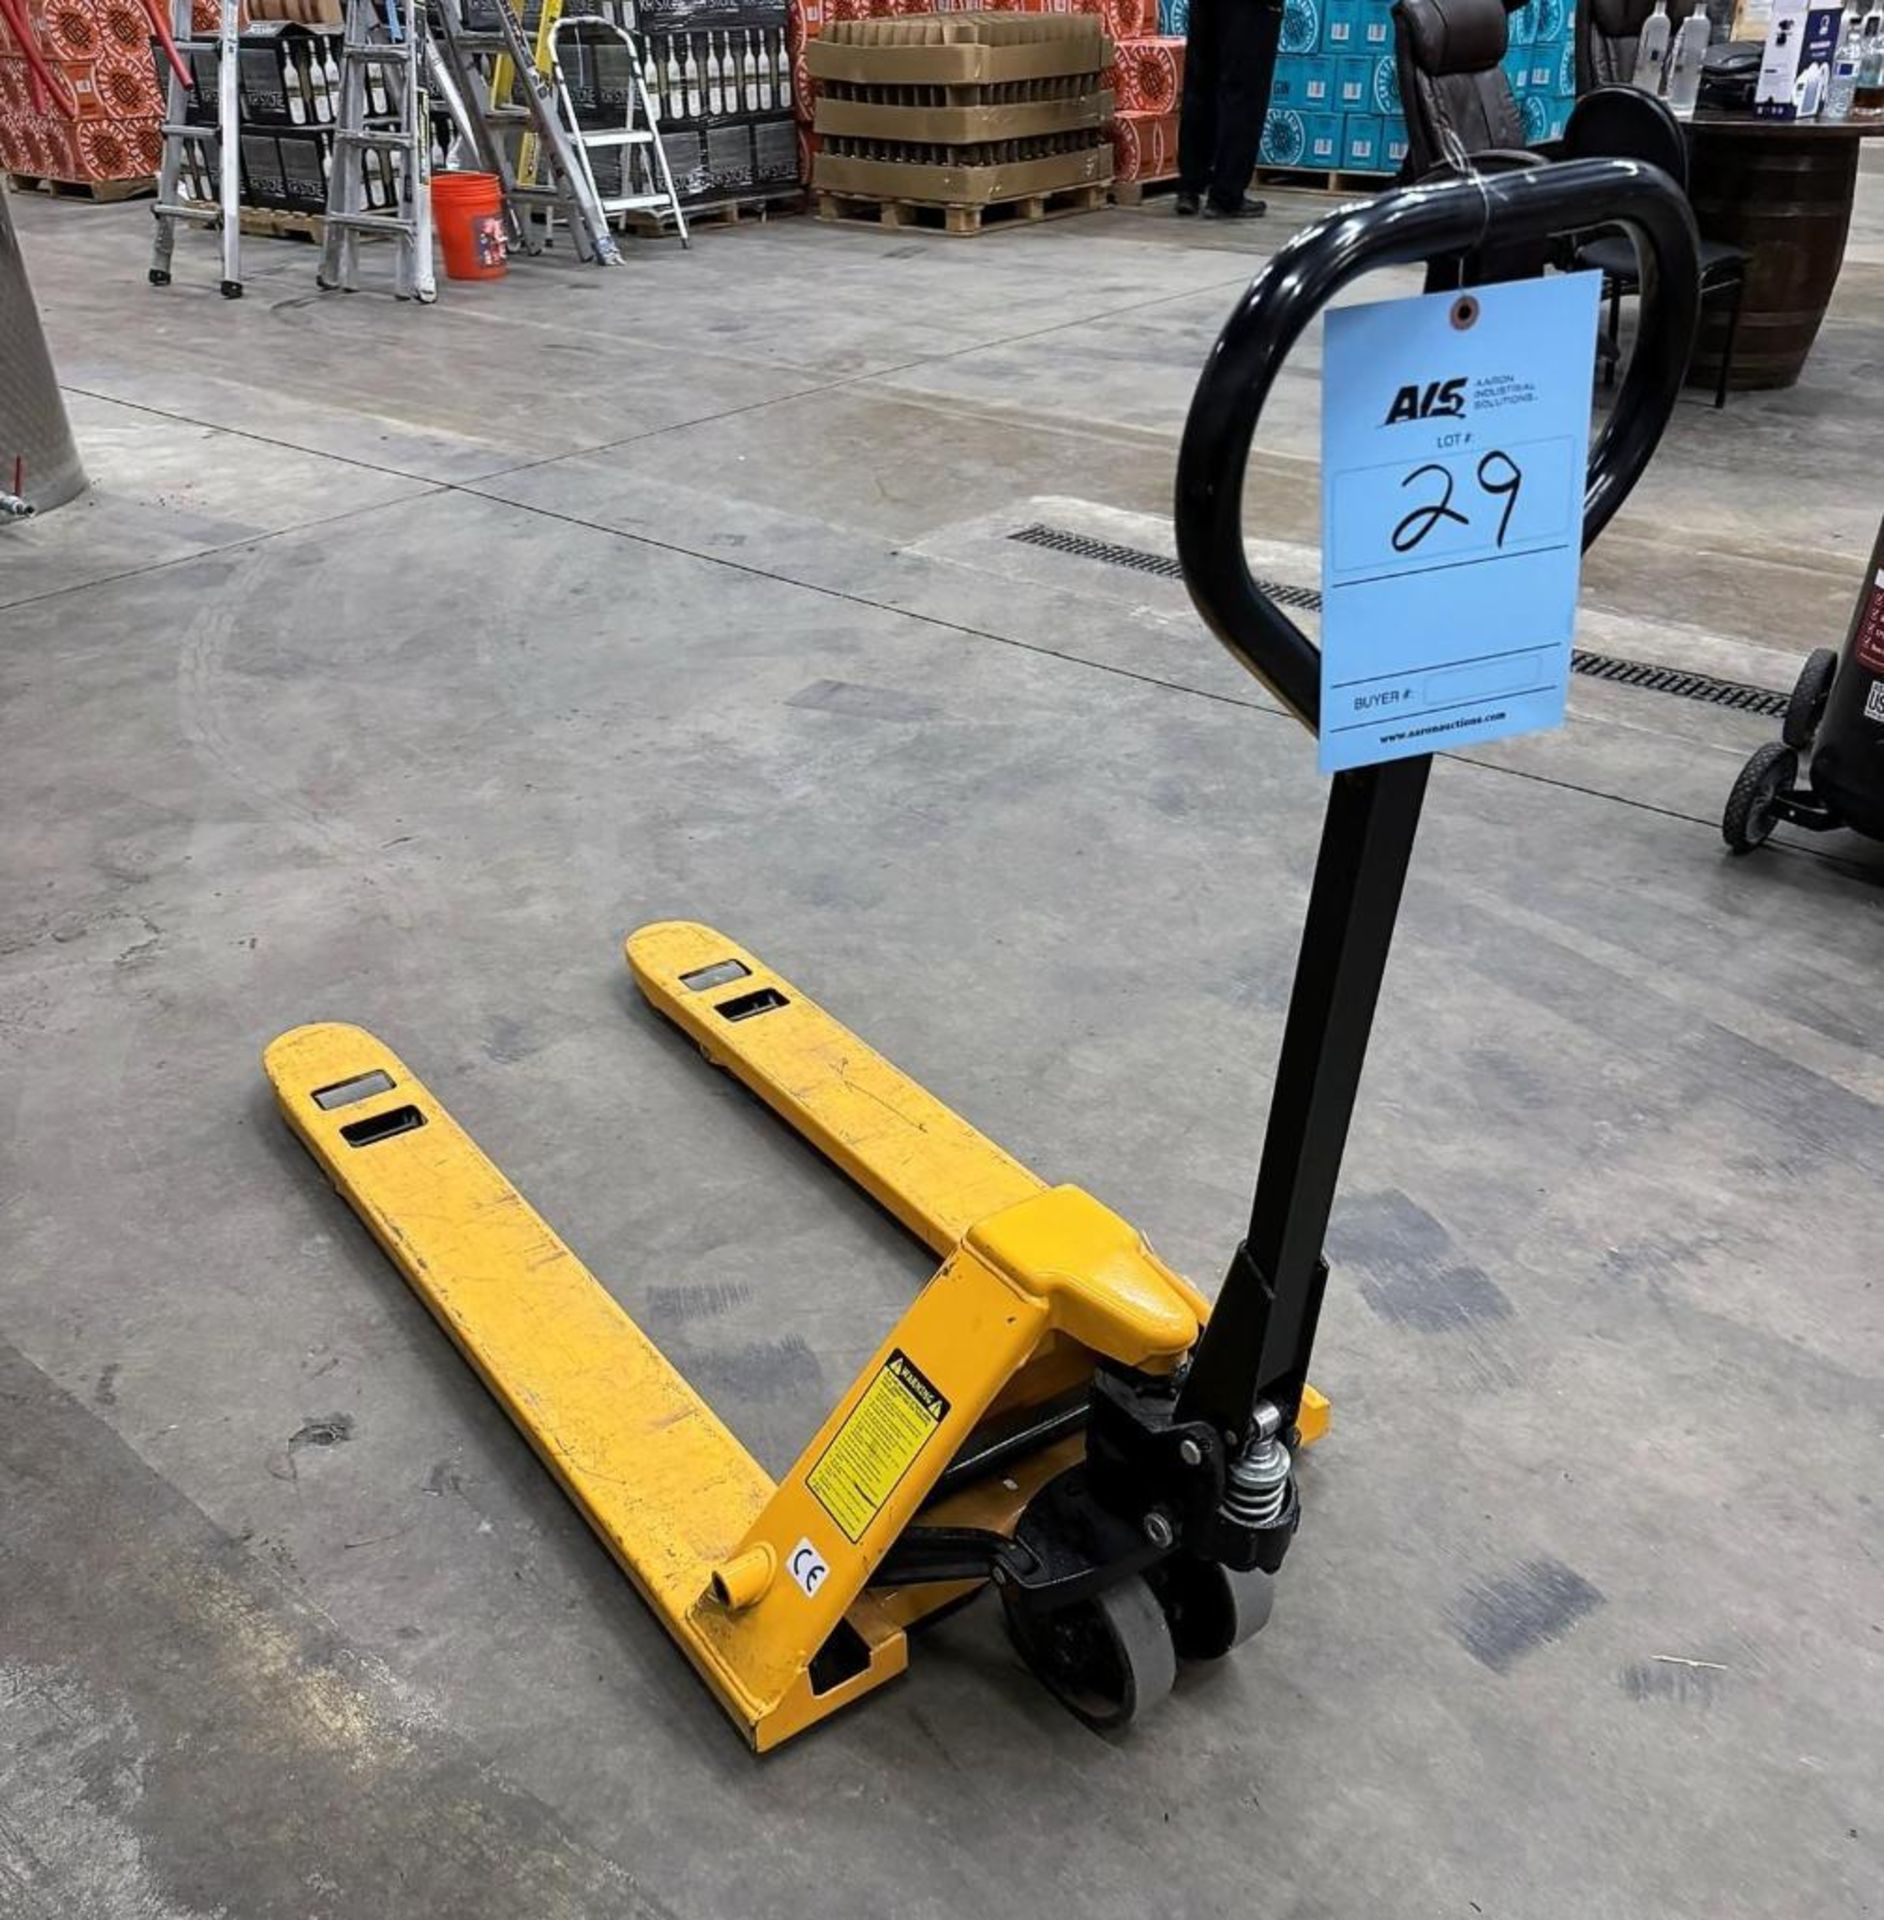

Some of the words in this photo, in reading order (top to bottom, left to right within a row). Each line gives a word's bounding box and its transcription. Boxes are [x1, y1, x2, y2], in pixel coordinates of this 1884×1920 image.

[1384, 377, 1469, 426] AIS
[1437, 434, 1461, 449] LOT
[1391, 450, 1522, 552] 29
[1354, 690, 1400, 711] BUYER
[1380, 711, 1506, 744] www.aaronauctions.com
[901, 1366, 936, 1405] WARNING
[793, 1548, 826, 1593] CE
